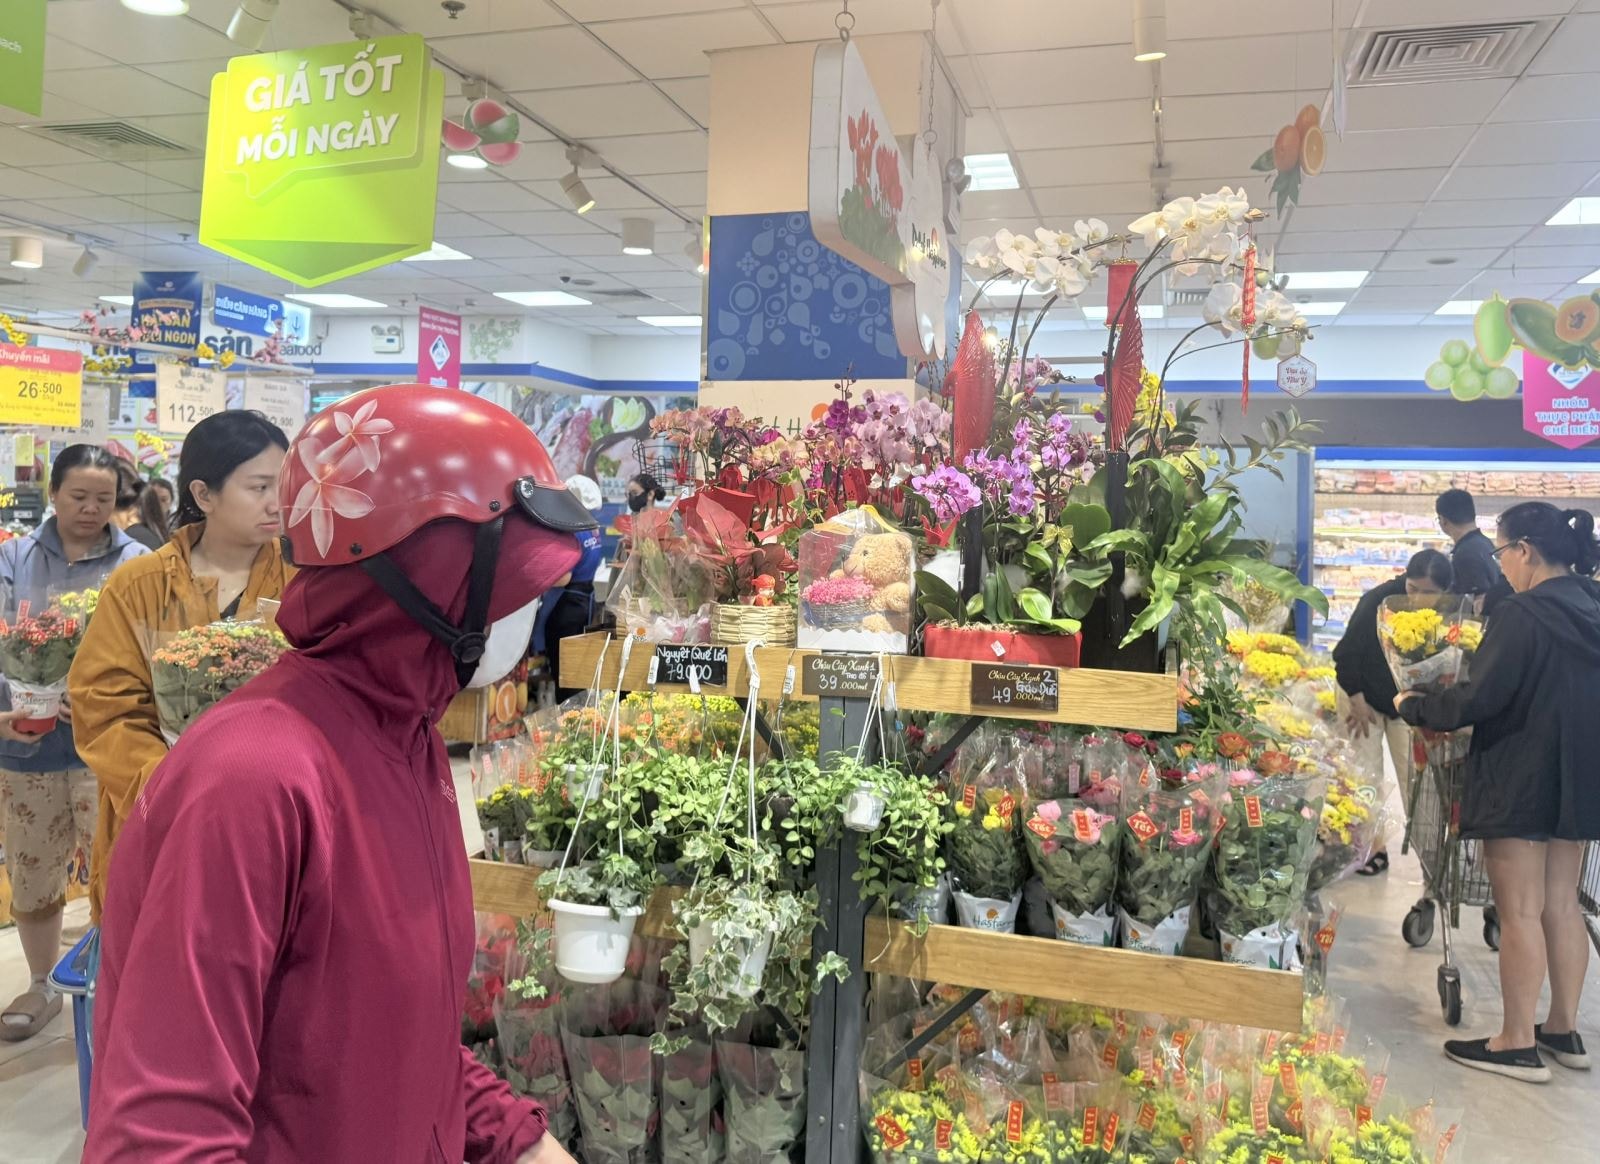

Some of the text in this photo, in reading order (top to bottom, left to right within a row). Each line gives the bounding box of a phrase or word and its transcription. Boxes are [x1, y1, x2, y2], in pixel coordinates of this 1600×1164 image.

[245, 44, 402, 112] GIÁ TỐT
[236, 110, 399, 165] MỖI NGÀY
[165, 329, 197, 345] NGON
[203, 327, 252, 356] sản
[278, 341, 322, 356] eafood
[1552, 396, 1589, 409] NHÓM
[1535, 411, 1571, 425] THỰC
[1543, 422, 1599, 436] CHẾ BIẾN
[657, 645, 728, 663] Nguyệt Quế Lớn
[811, 658, 830, 671] Chậu
[831, 659, 847, 675] Cây
[847, 660, 869, 671] Xanh
[818, 673, 838, 690] 39
[988, 669, 1056, 684] Chậu Cây Xanh 2
[992, 685, 1011, 703] 49
[1133, 818, 1151, 832] Tết
[880, 1121, 899, 1140] Tết
